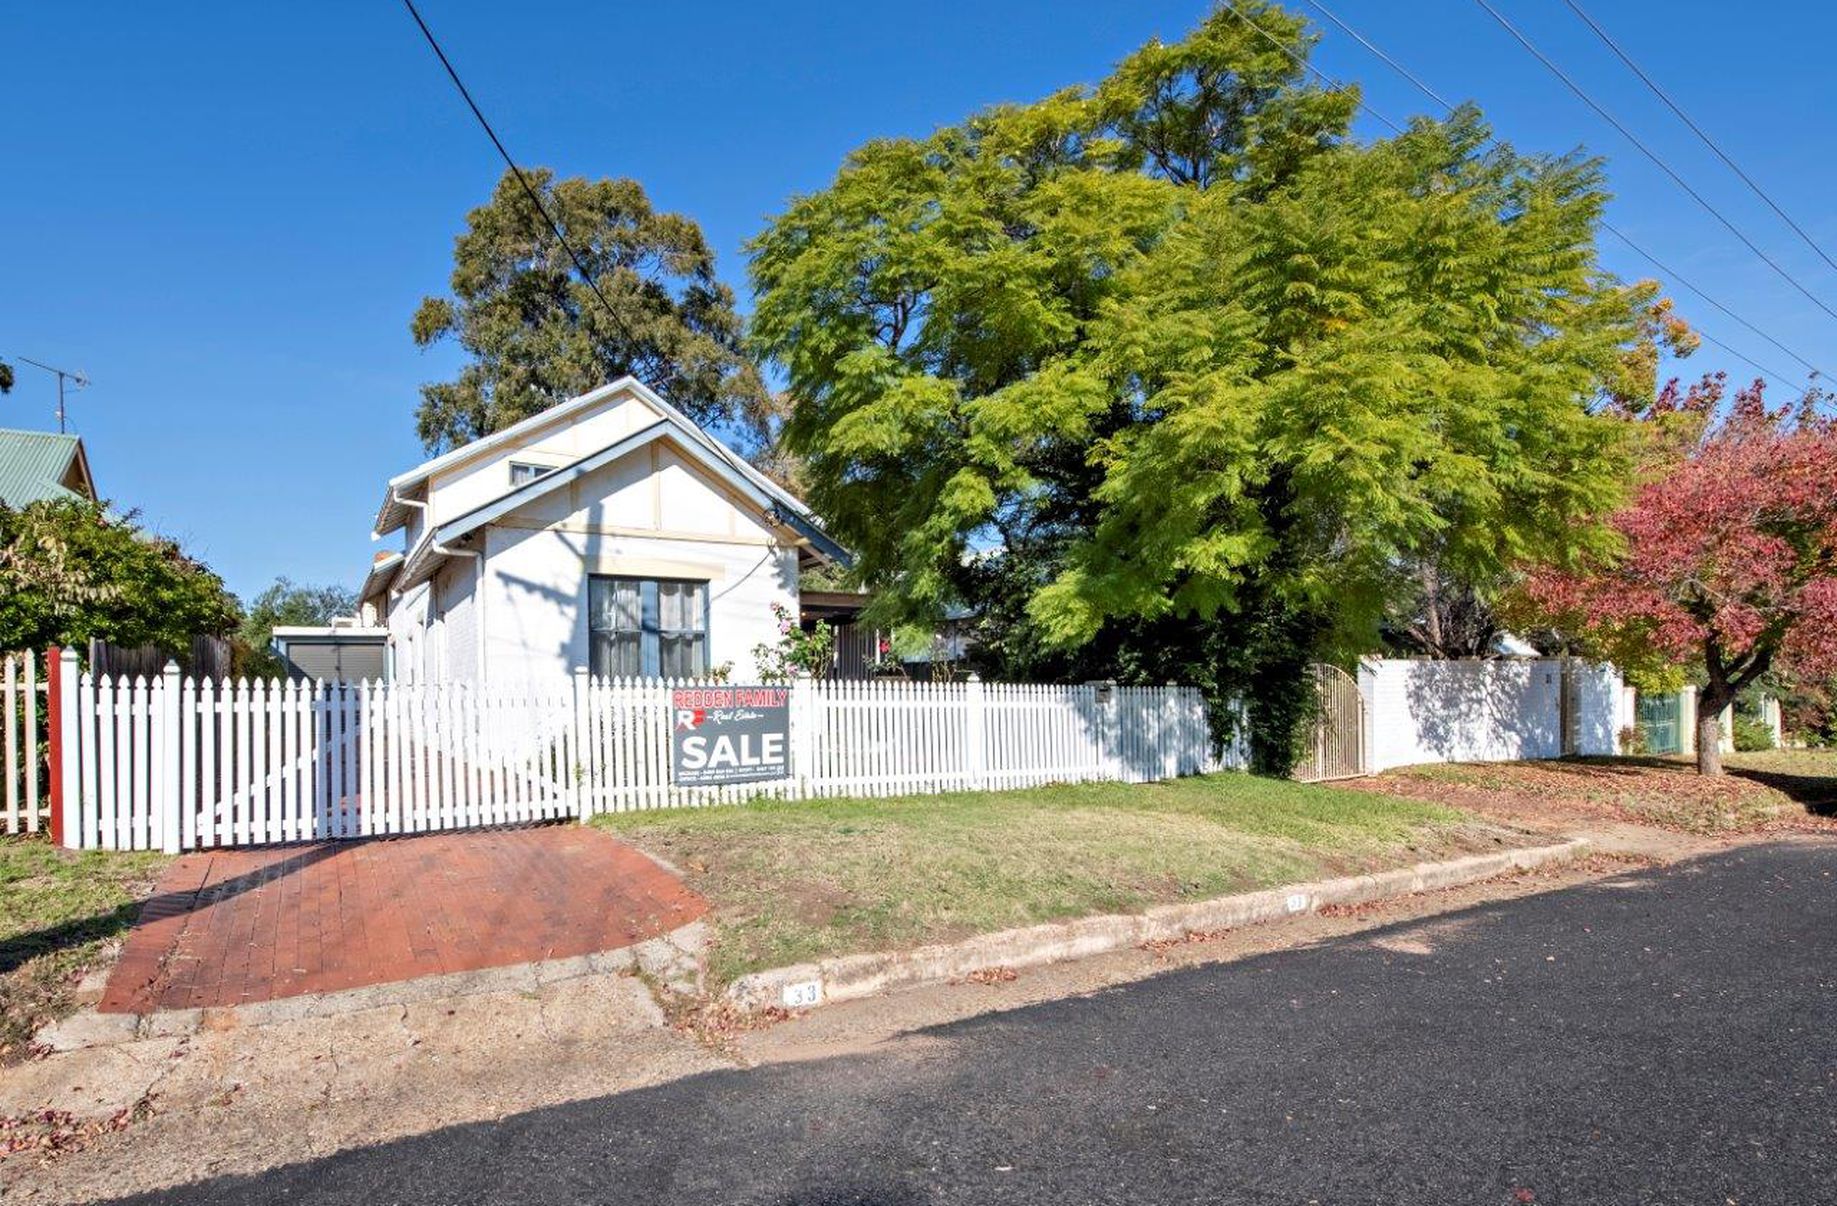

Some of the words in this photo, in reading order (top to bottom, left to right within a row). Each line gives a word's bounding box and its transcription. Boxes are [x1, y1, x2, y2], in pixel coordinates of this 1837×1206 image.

[673, 689, 733, 709] REDDEN
[735, 688, 787, 708] FAMILY
[681, 733, 784, 769] SALE
